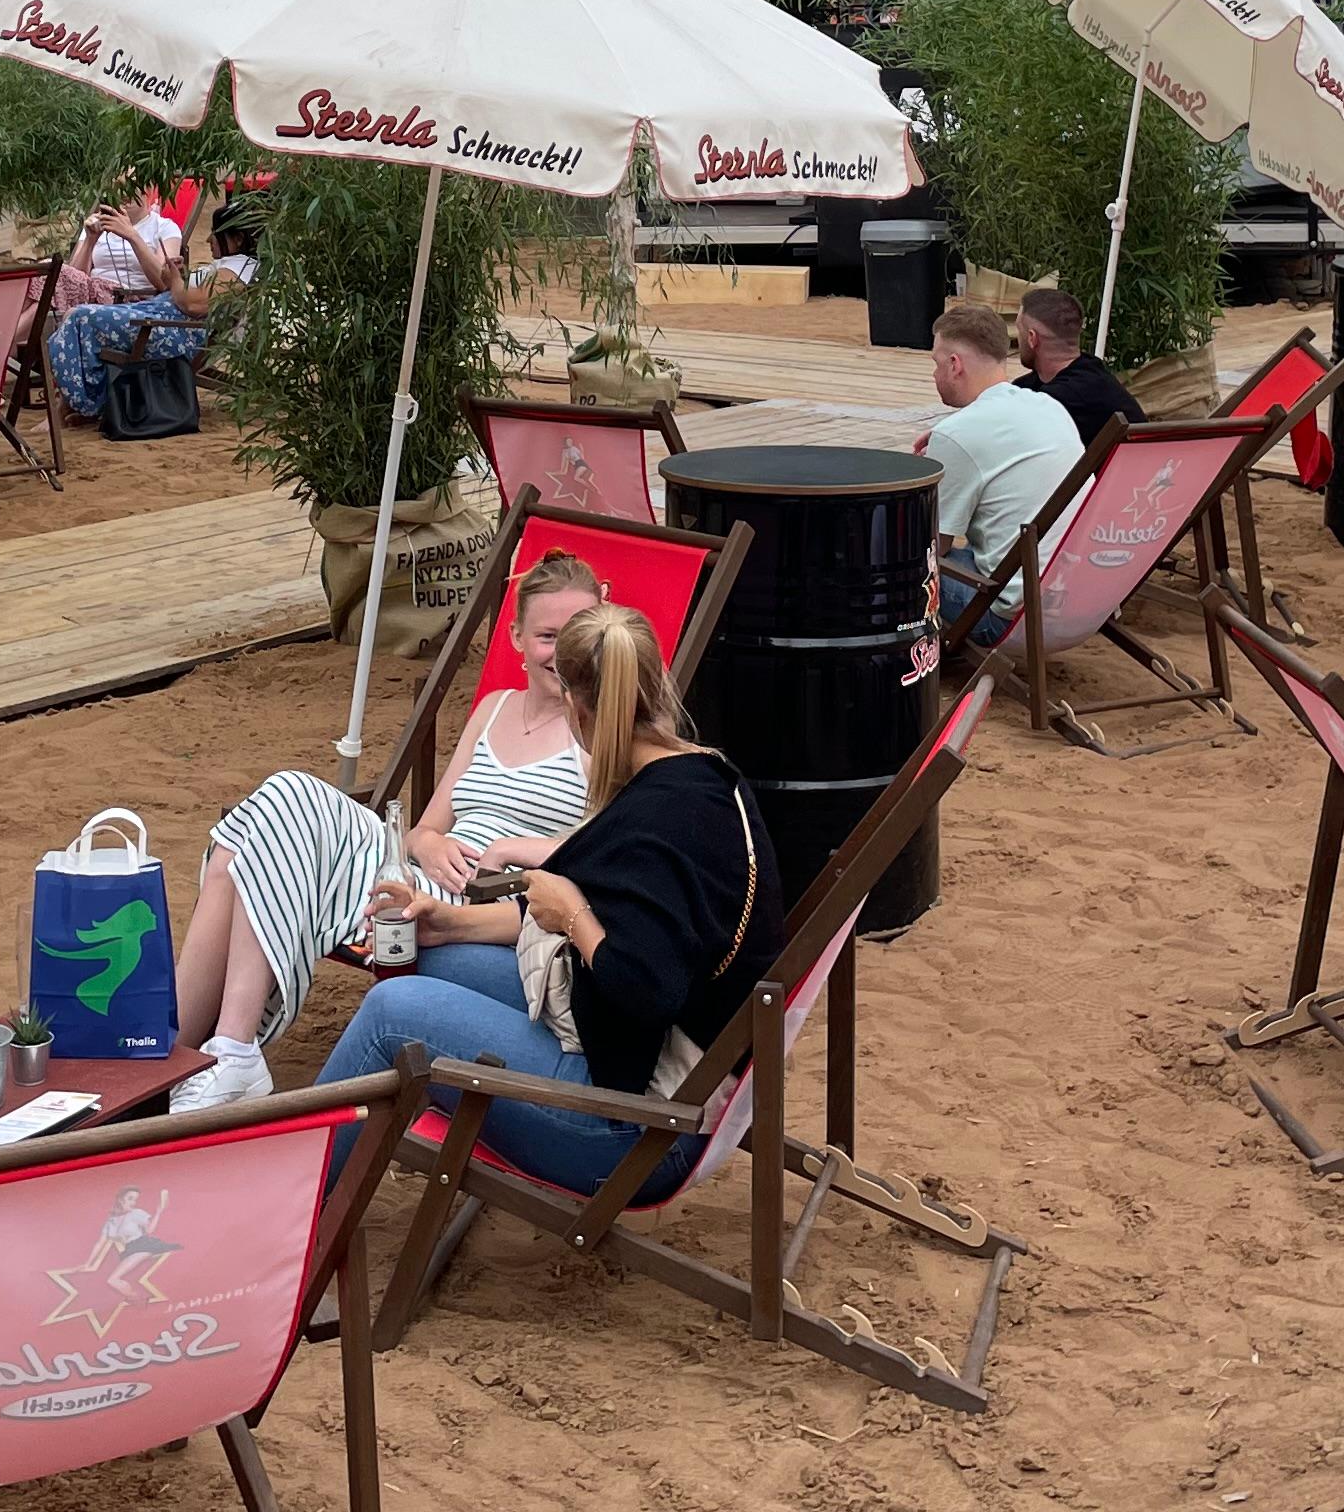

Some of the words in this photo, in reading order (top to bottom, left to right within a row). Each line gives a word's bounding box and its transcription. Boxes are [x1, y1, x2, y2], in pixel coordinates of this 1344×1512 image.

[0, 0, 103, 66] Sternla
[103, 48, 184, 106] Schmeckt!
[275, 88, 438, 150] Sternla
[446, 124, 583, 176] Schmeckt!
[694, 134, 787, 185] Sternla
[791, 149, 879, 183] Schmeckt!
[397, 539, 466, 570] FAZENDA
[125, 1036, 157, 1047] Thalia
